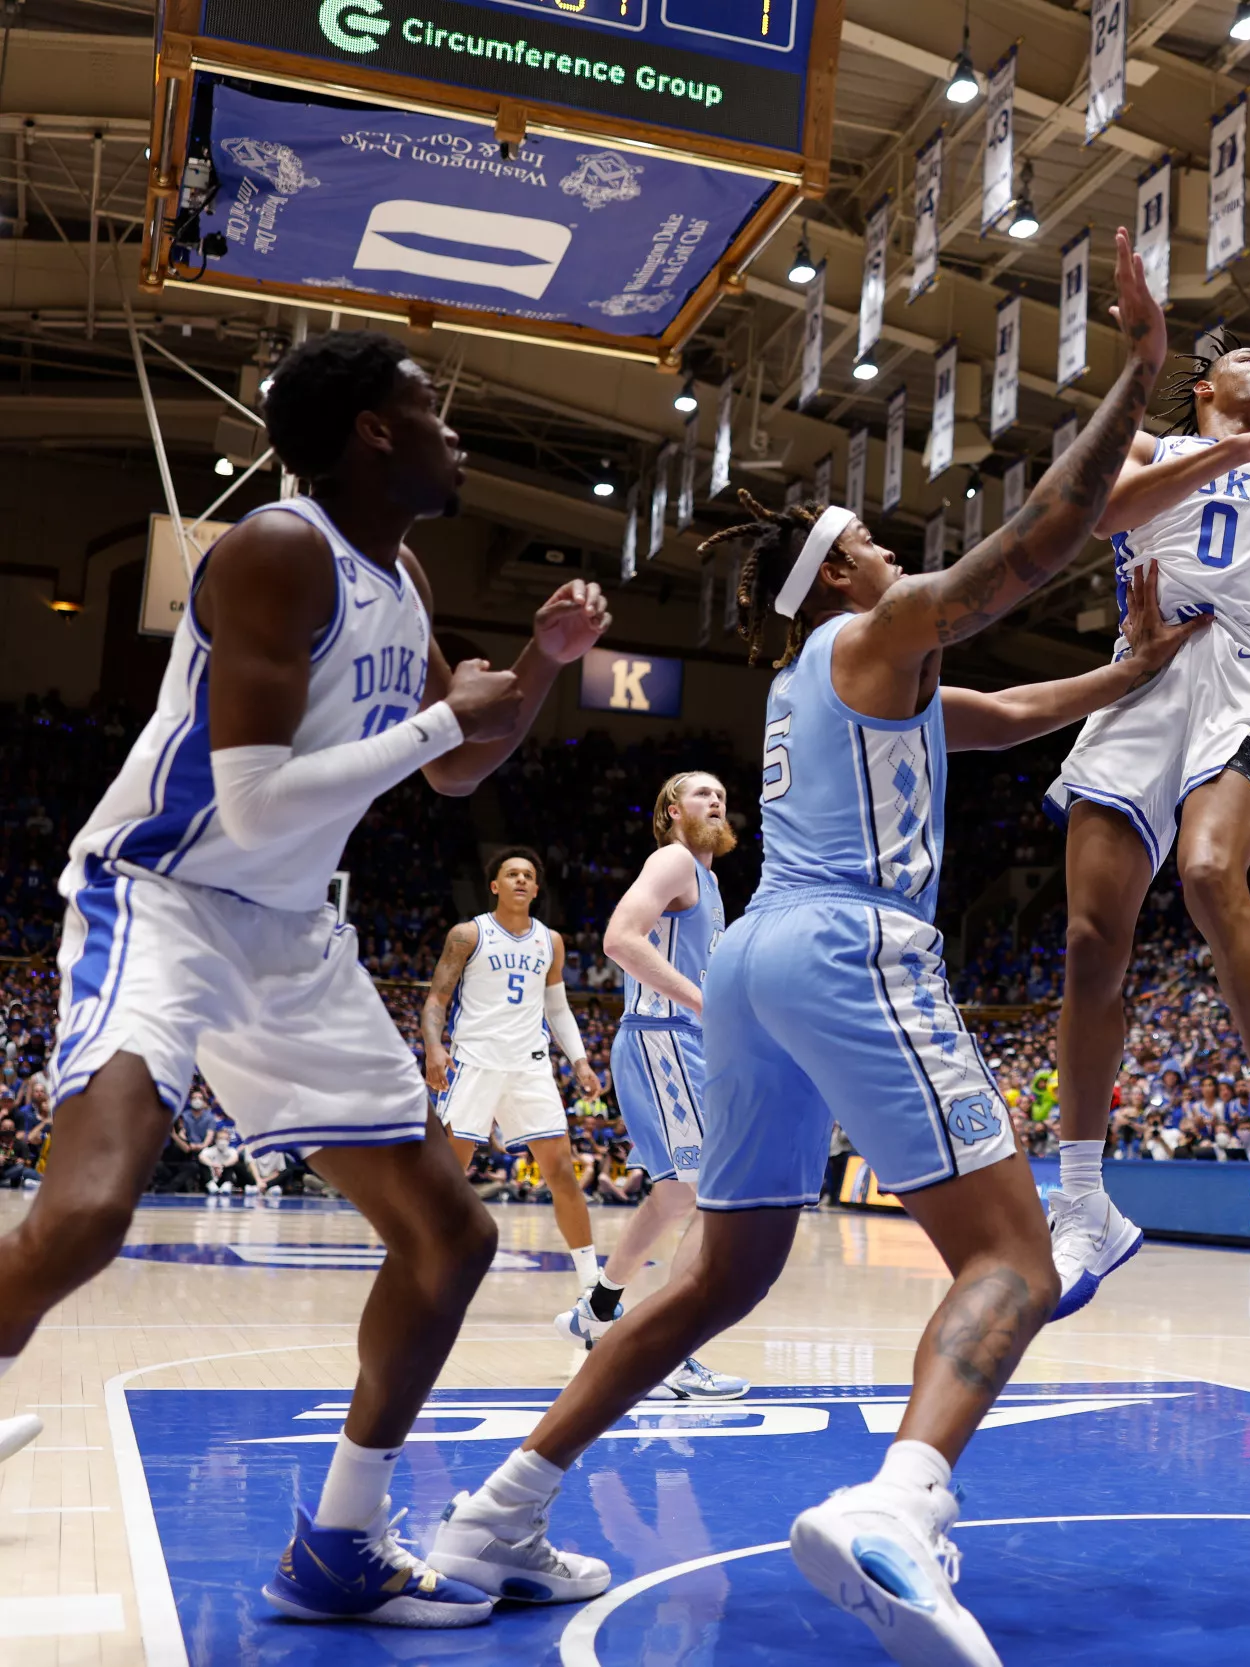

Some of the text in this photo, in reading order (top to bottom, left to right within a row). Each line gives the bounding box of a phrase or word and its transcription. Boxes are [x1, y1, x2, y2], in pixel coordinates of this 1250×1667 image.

[402, 17, 723, 107] Circumference Group
[411, 144, 548, 188] Washington
[1197, 500, 1239, 569] 0
[609, 659, 652, 711] K
[762, 710, 793, 804] 5
[488, 953, 545, 975] DUKE
[507, 973, 525, 1005] 5
